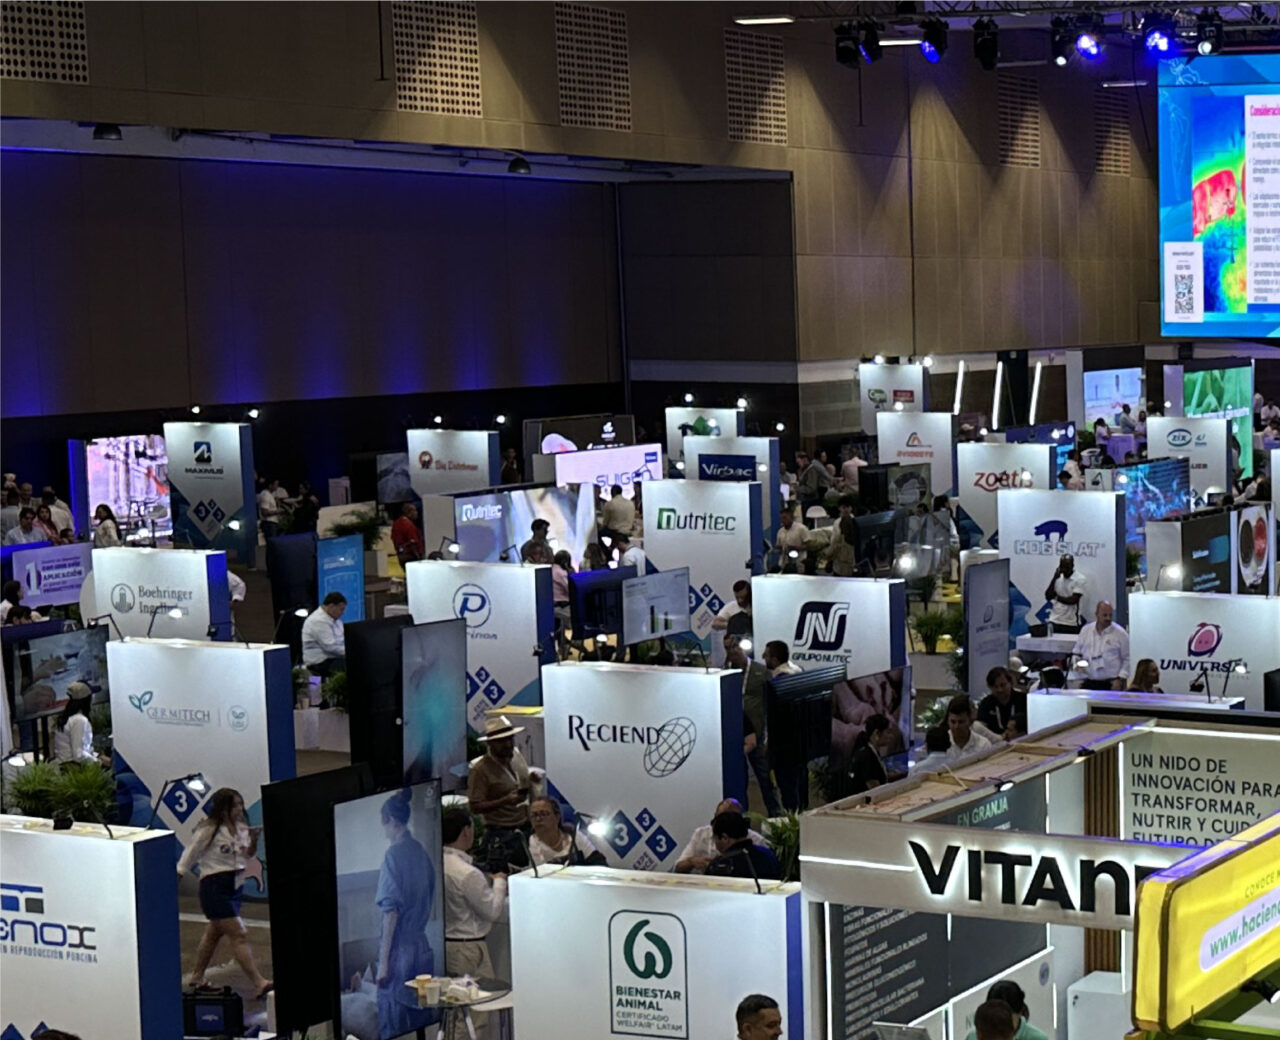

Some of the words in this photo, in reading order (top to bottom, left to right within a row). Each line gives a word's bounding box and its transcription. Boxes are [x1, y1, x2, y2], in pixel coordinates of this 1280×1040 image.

[702, 463, 753, 477] Virbac
[1057, 541, 1099, 557] SLAT
[138, 585, 193, 600] Boehringer
[792, 653, 822, 663] GRUPO
[822, 653, 851, 664] NUTEC
[1131, 753, 1153, 768] UN
[1160, 755, 1200, 772] NIDO
[1206, 759, 1228, 774] DE
[1132, 773, 1236, 795] INNOVACIÓN
[971, 796, 1009, 824] GRANJA
[1131, 793, 1262, 820] TRANSFORMAR,
[1132, 812, 1191, 831] NUTRIR
[1197, 818, 1206, 831] Y
[1245, 872, 1275, 898] CONOCE
[10, 945, 63, 960] REPRODUCCIÓN
[66, 951, 98, 964] PORCINA
[616, 986, 681, 1001] BIENESTAR
[616, 998, 663, 1011] ANIMAL
[616, 1010, 669, 1022] CERTIFICADO
[656, 1024, 682, 1032] LATAM
